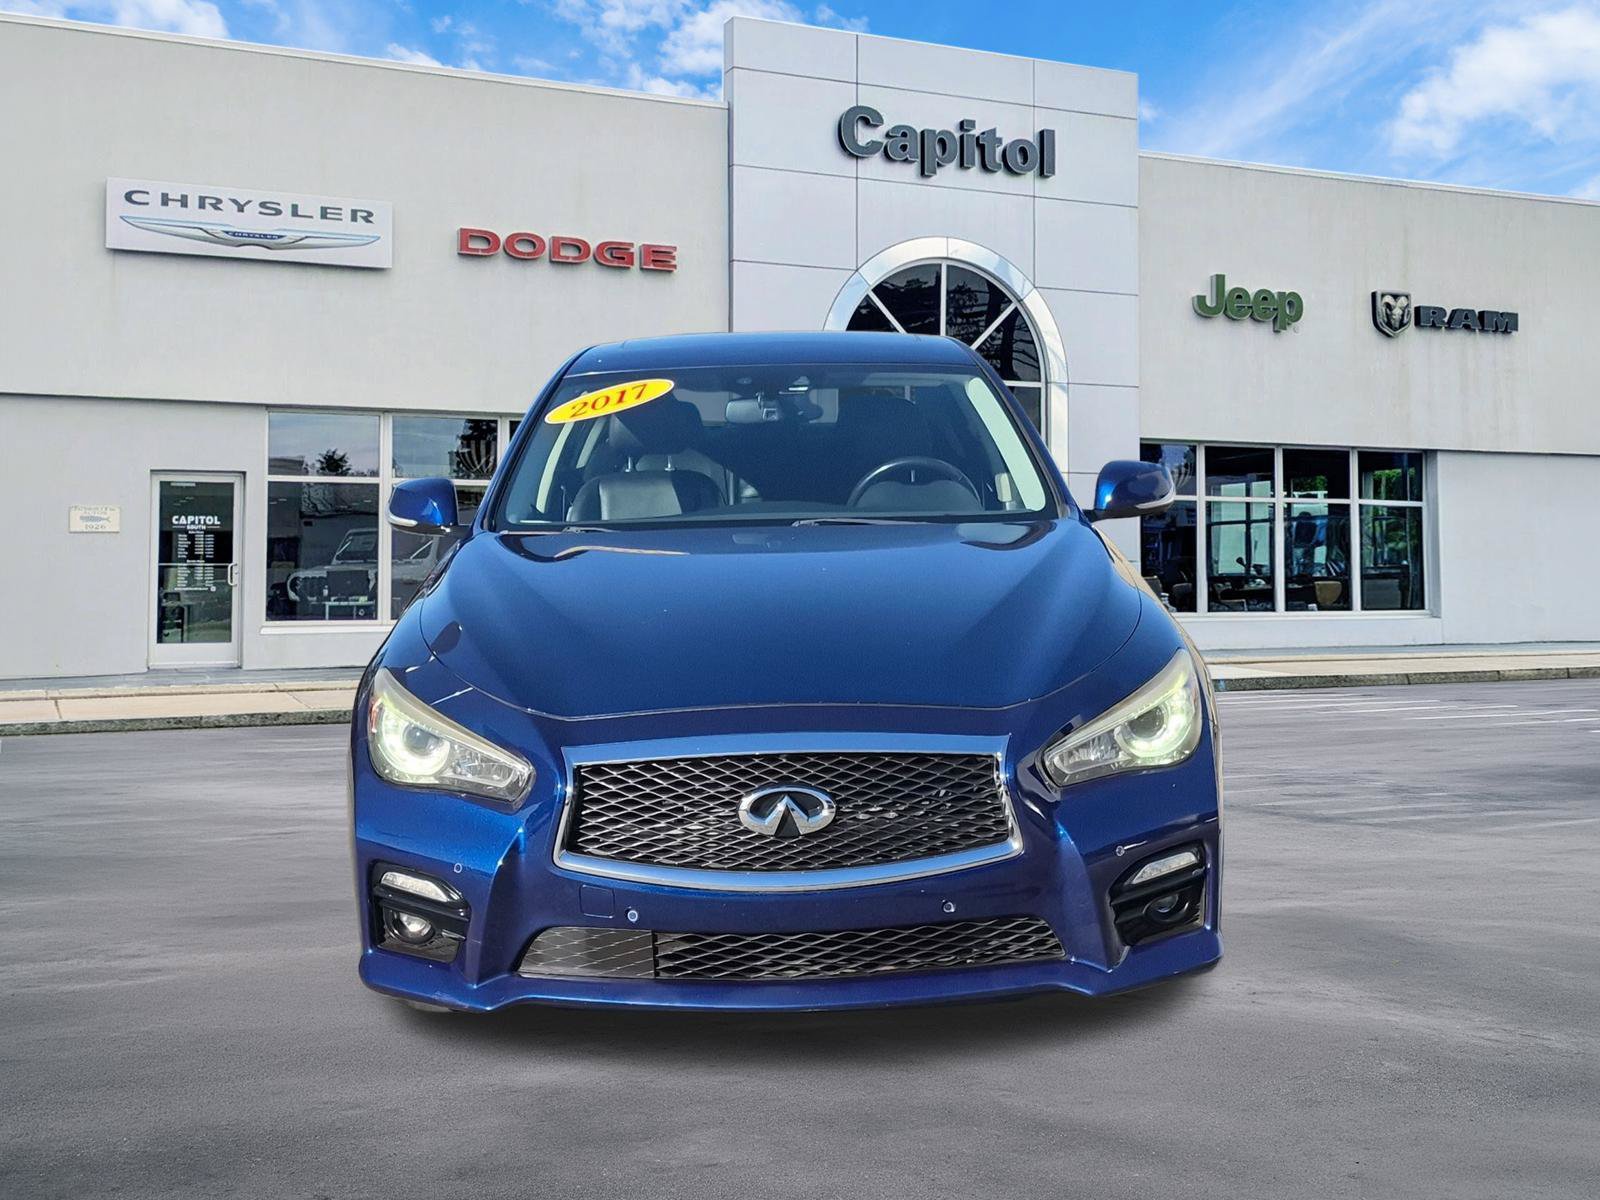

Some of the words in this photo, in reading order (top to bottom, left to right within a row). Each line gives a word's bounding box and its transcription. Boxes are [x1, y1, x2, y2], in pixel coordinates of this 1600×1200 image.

[837, 105, 1056, 177] Capitol
[123, 189, 375, 225] CHRYSLER
[457, 227, 678, 272] DODGE
[1192, 273, 1304, 333] Jeep
[1413, 305, 1519, 333] RAM
[568, 382, 649, 419] 2017
[172, 515, 221, 525] CAPITOL
